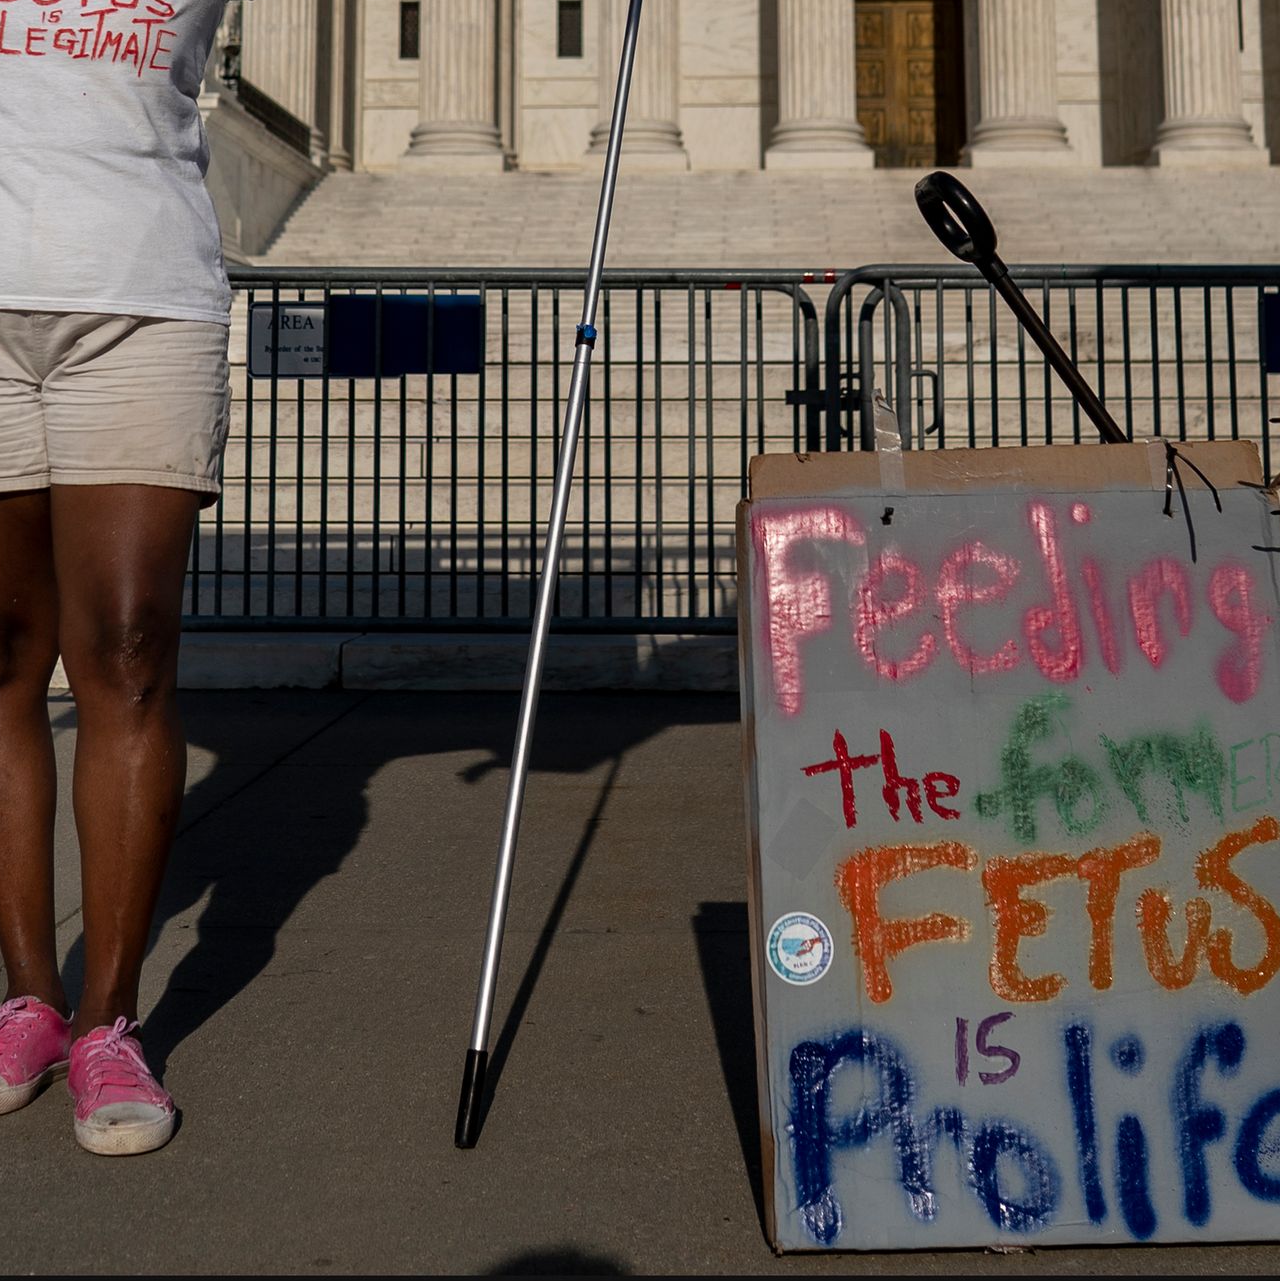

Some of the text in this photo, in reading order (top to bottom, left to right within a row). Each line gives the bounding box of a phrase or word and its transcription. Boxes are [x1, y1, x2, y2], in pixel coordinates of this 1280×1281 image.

[752, 498, 1274, 717] Feeding
[802, 728, 962, 829] the
[953, 1011, 1022, 1087] IS
